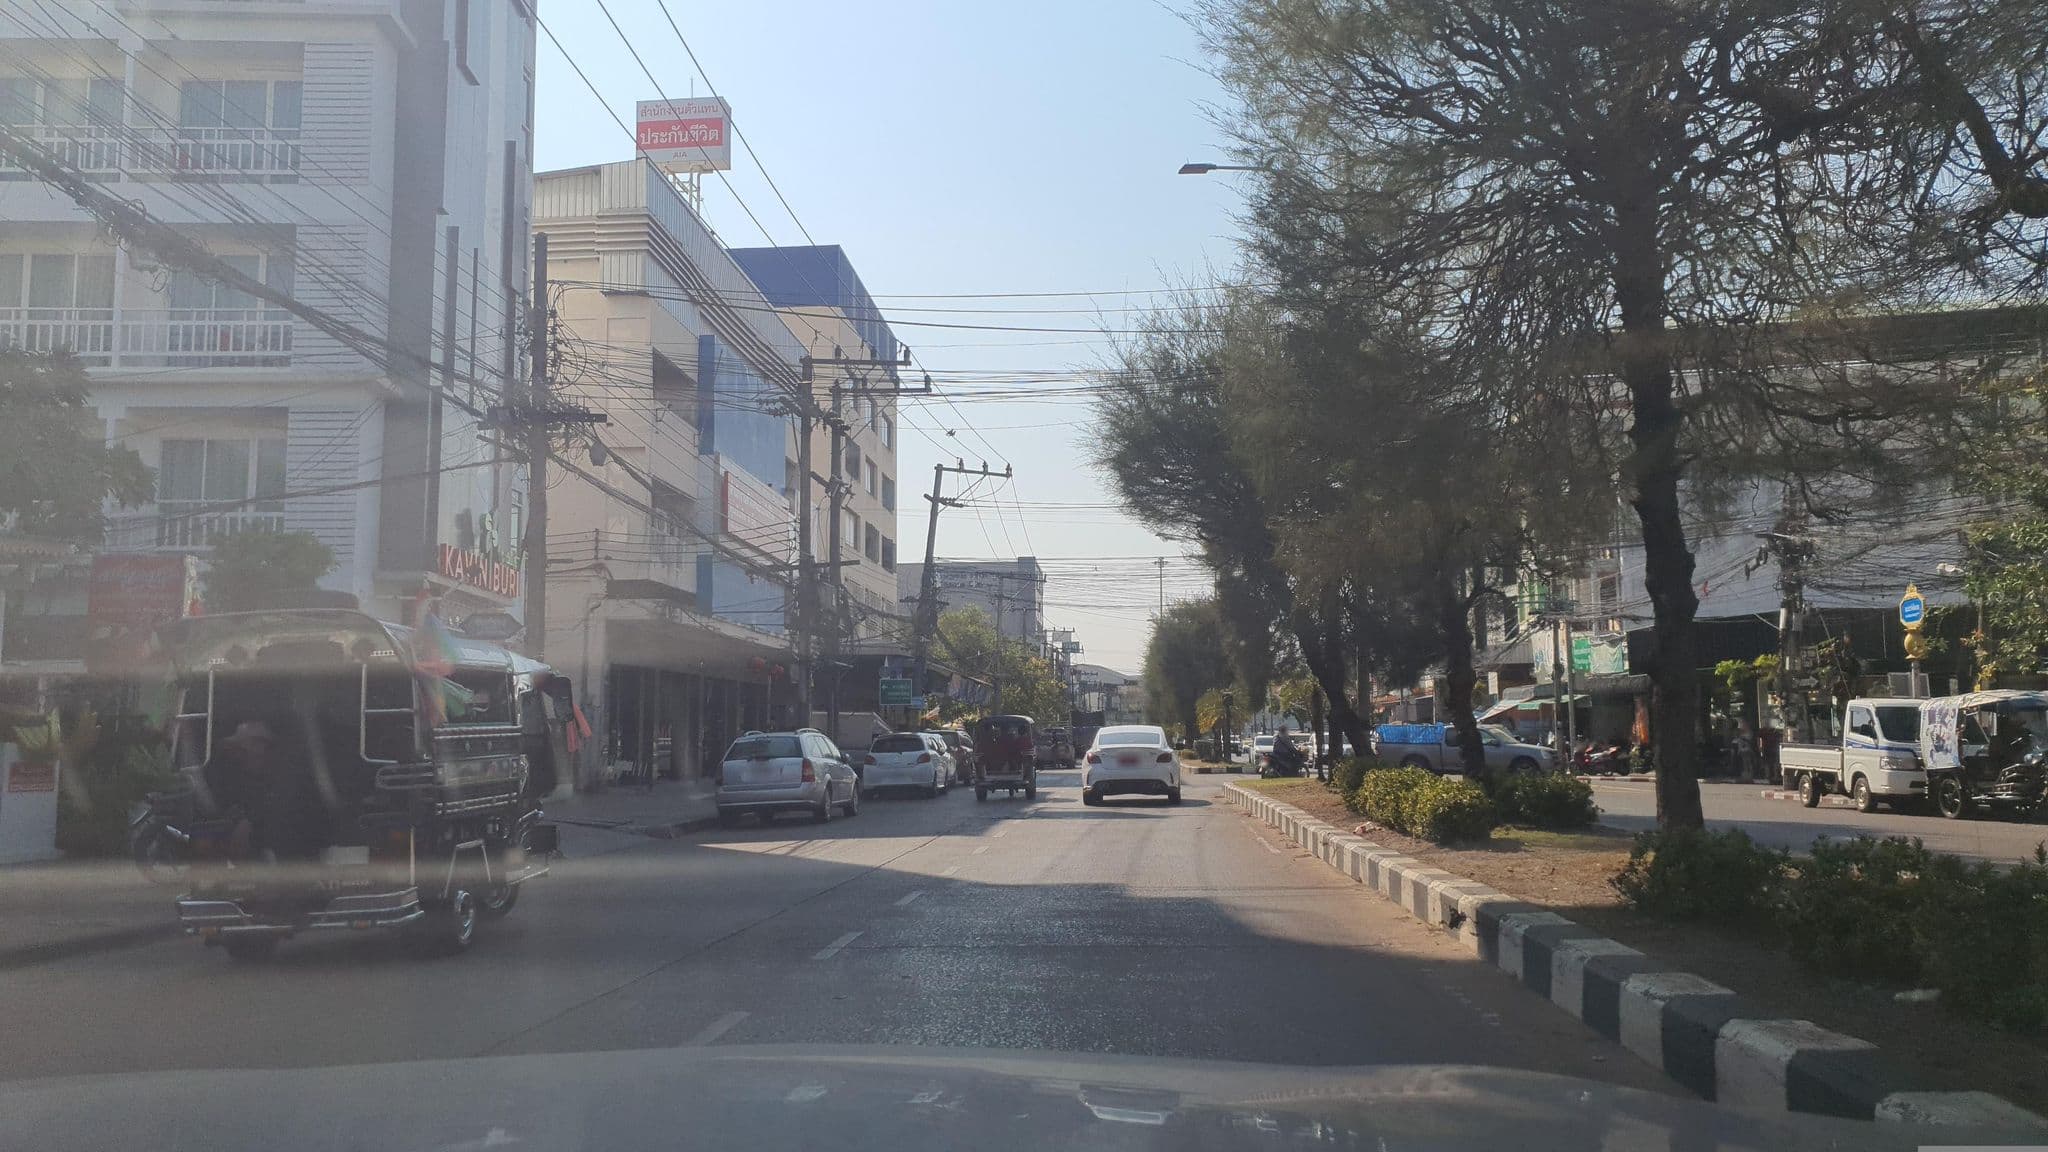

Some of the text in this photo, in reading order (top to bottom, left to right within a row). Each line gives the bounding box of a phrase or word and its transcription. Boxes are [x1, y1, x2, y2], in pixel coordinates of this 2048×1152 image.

[640, 124, 719, 145] ประกันชีวิต
